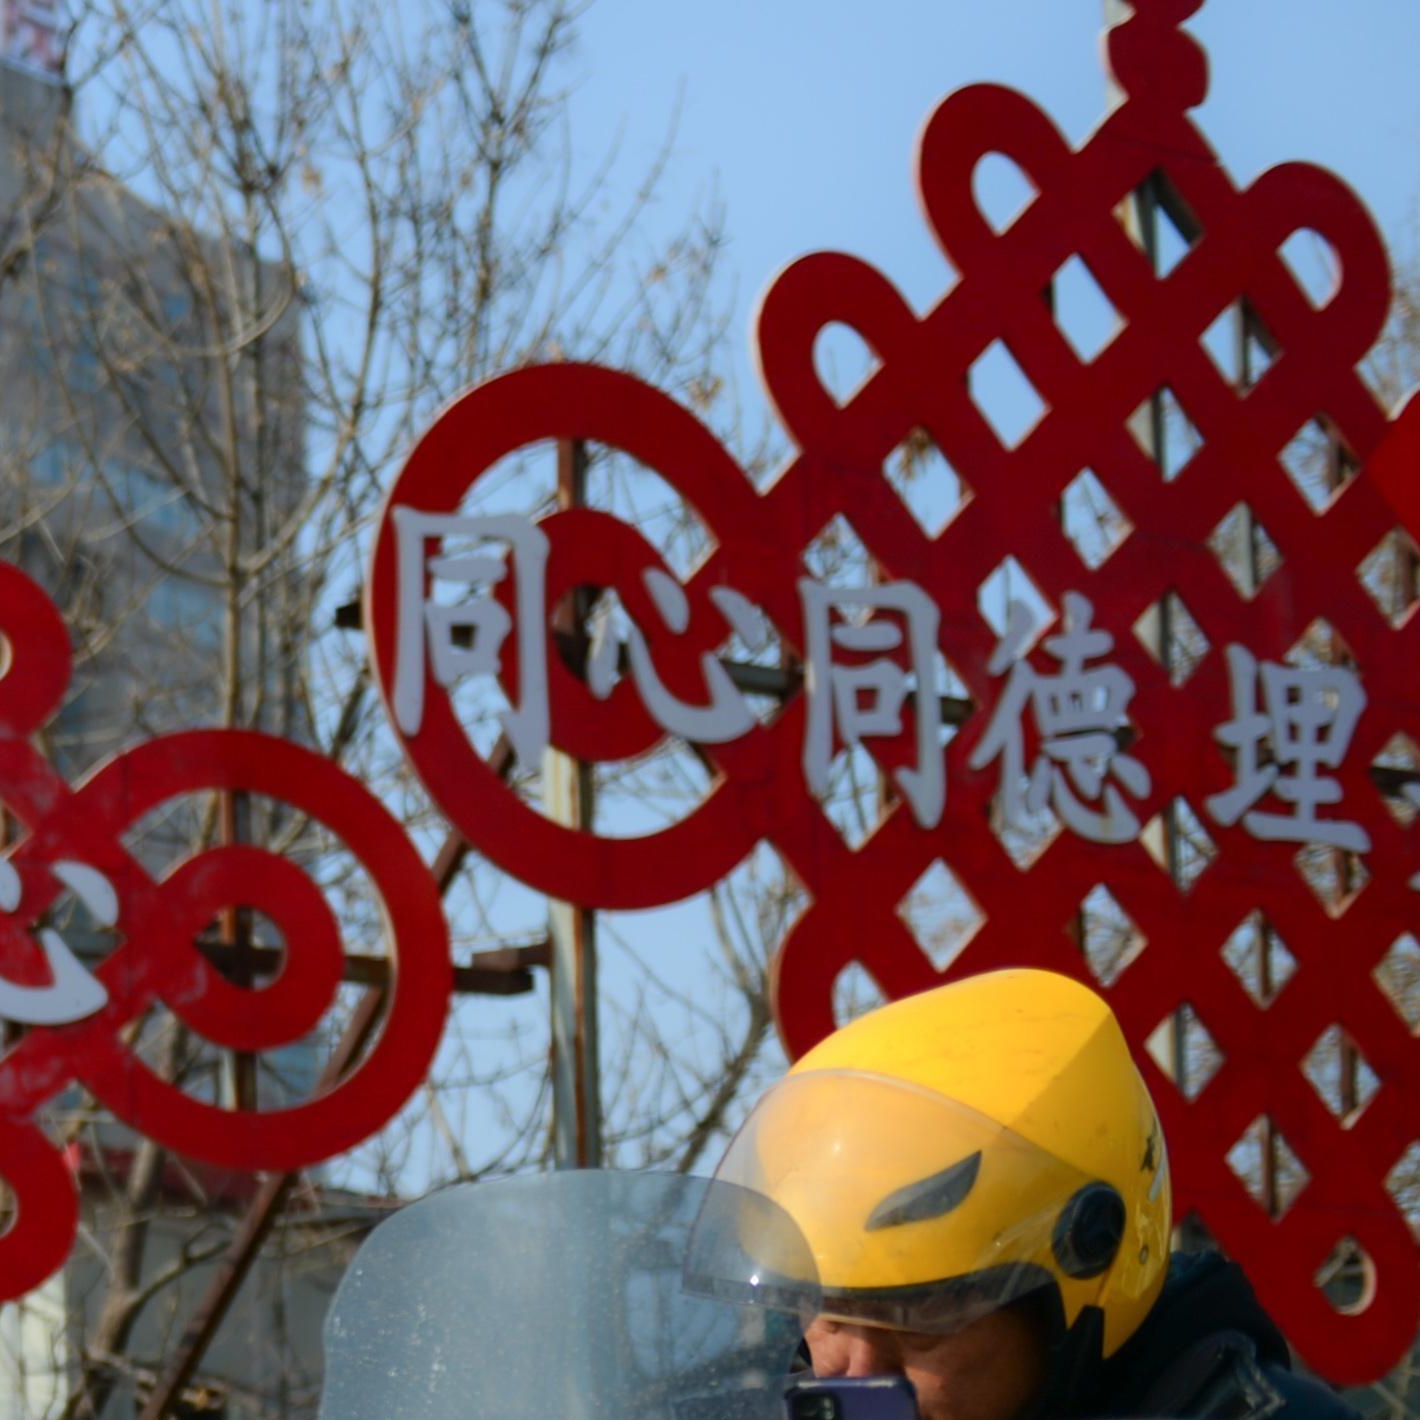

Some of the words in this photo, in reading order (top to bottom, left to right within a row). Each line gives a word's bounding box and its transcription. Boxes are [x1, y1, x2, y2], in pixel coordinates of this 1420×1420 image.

[392, 503, 1372, 854] 同心同德埋
